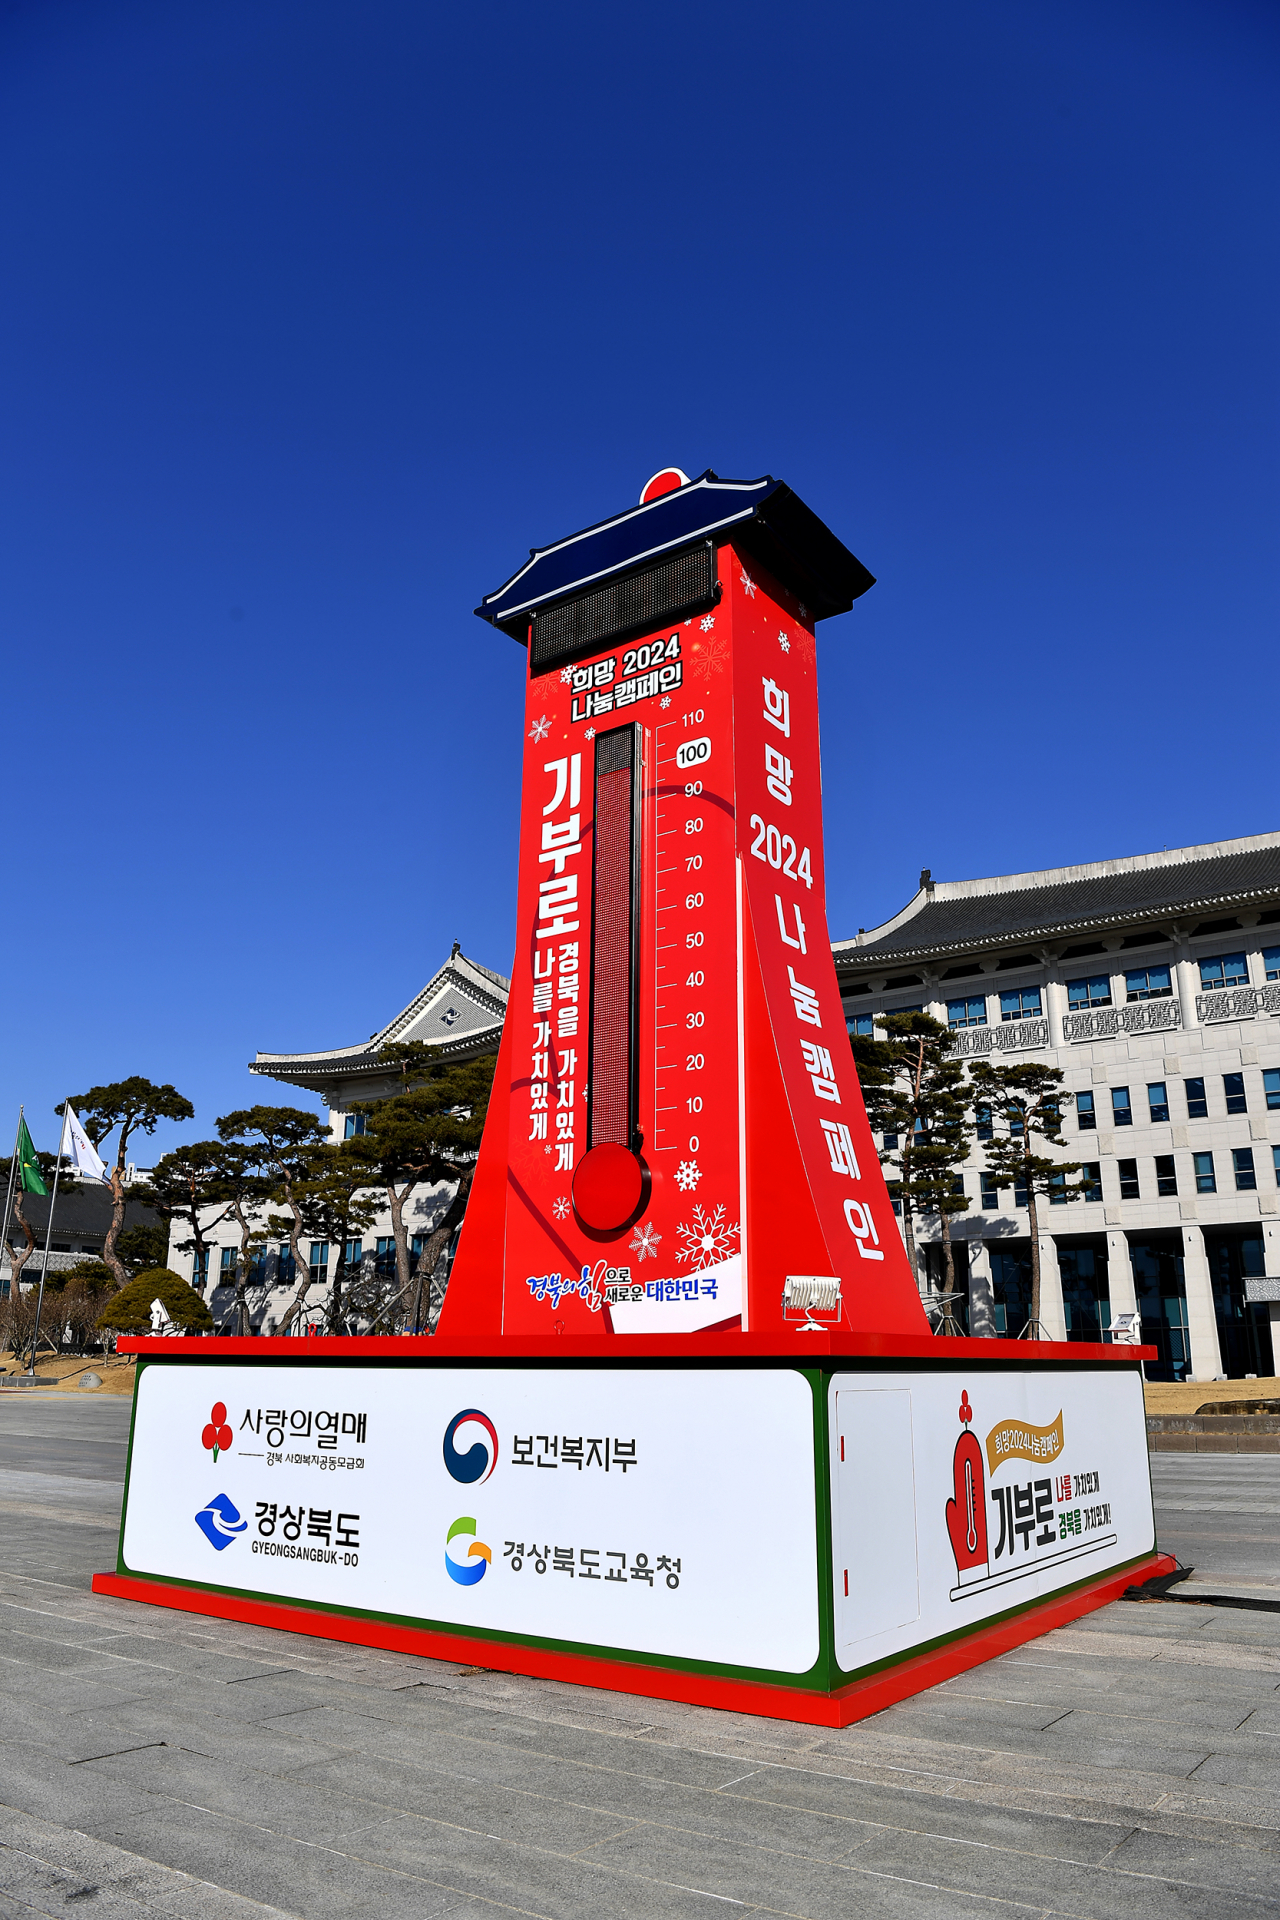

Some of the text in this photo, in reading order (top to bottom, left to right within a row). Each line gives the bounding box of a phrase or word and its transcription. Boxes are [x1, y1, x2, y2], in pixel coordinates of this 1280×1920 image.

[572, 634, 681, 692] 희망 2024
[572, 663, 682, 722] 나눔캠페인
[681, 708, 705, 728] 110
[678, 741, 708, 764] 100
[684, 780, 703, 797] 90
[684, 817, 704, 834] 80
[535, 752, 582, 939] 기부로
[684, 854, 703, 872] 70
[685, 892, 704, 909] 60
[685, 931, 705, 948] 50
[685, 971, 705, 988] 40
[750, 676, 885, 1261] 희망 2024 나눔캠페인
[685, 1011, 705, 1029] 30
[528, 947, 556, 1141] 나를 가치있게
[554, 941, 580, 1172] 경북을 가치있게
[685, 1053, 705, 1071] 20
[685, 1096, 703, 1114] 10
[689, 1135, 700, 1153] 0
[527, 1273, 575, 1308] 경북의
[604, 1278, 719, 1302] 새로운 대한민국
[239, 1408, 367, 1450] 사랑의열매
[266, 1451, 365, 1471] 경북 사회복지공동모금회
[511, 1434, 638, 1473] 보건복지부
[254, 1501, 361, 1548] 경상북도
[991, 1470, 1100, 1560] 기부로 나를 가치있게
[1058, 1508, 1082, 1540] 경북을
[252, 1540, 359, 1568] GYEONGSANGBUK-DO
[503, 1540, 682, 1590] 경상북도교육청
